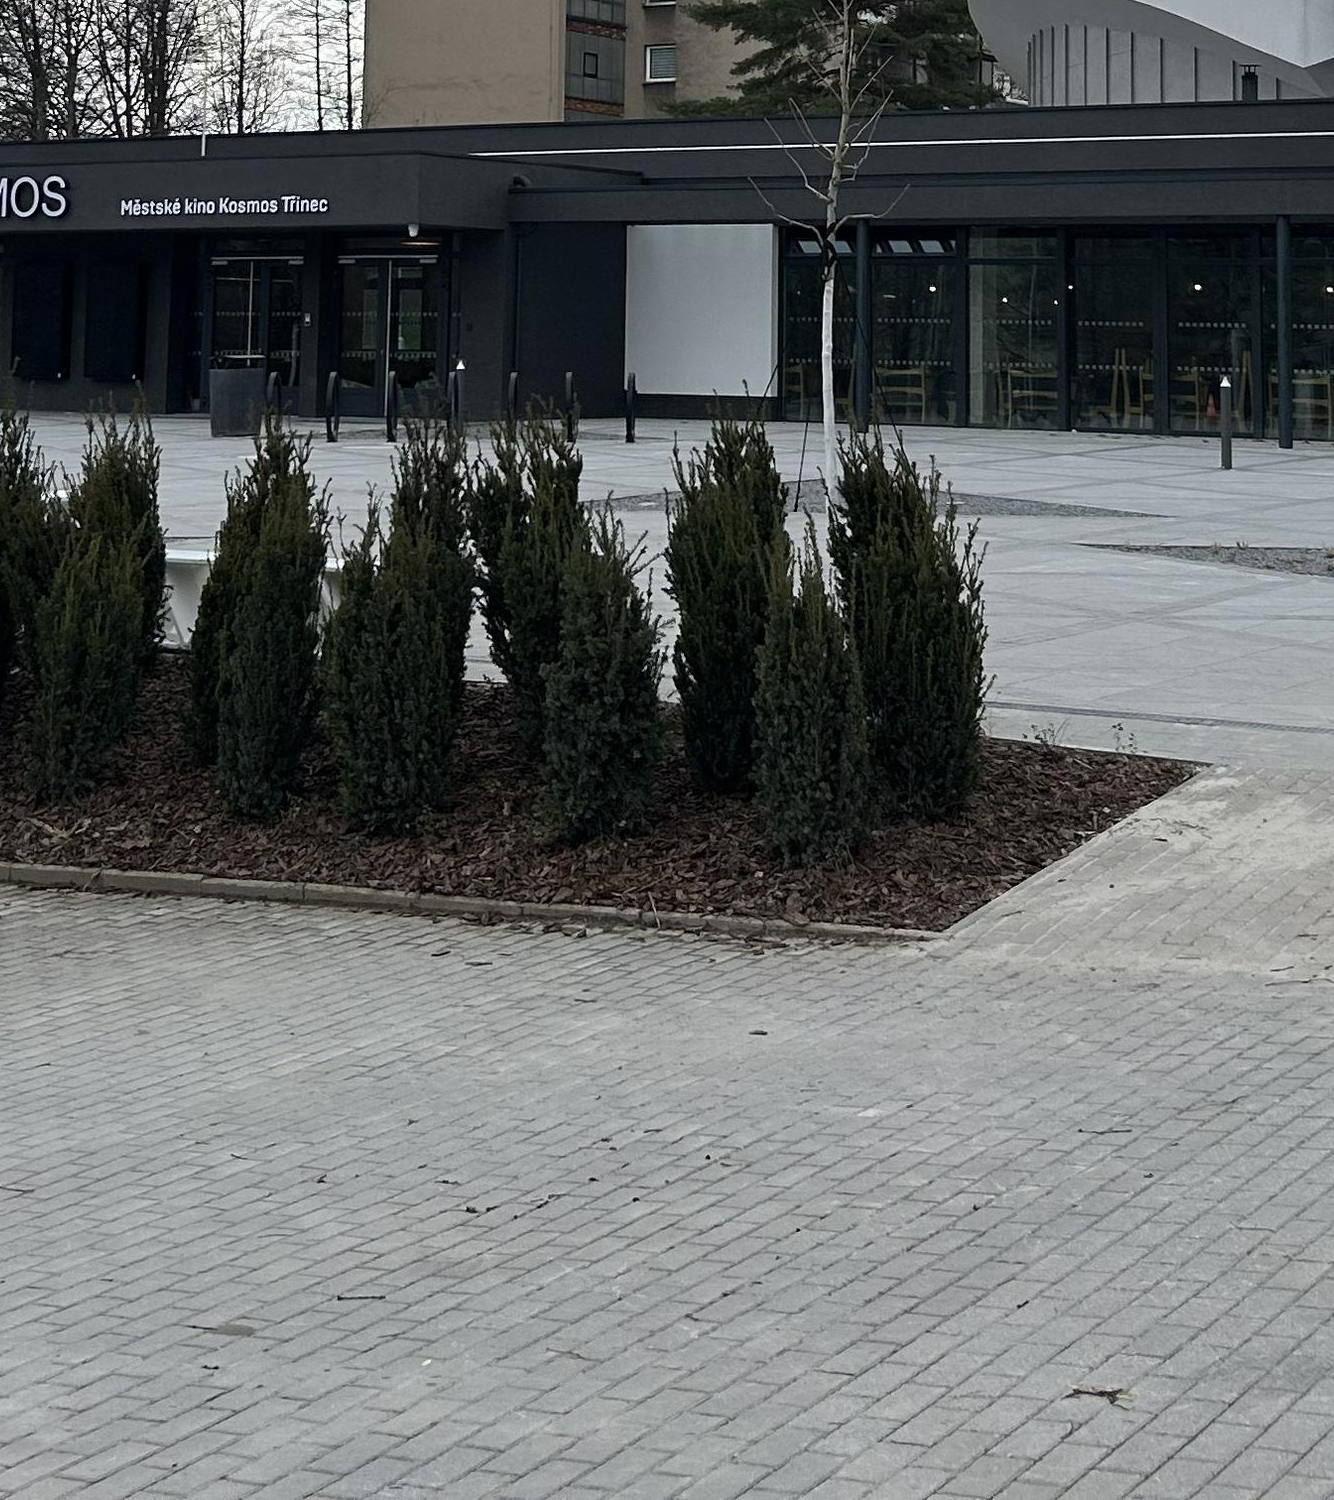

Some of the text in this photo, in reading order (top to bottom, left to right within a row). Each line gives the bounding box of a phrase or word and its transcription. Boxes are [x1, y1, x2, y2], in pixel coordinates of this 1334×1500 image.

[120, 195, 328, 216] Městské kino Kosmos Třinec
